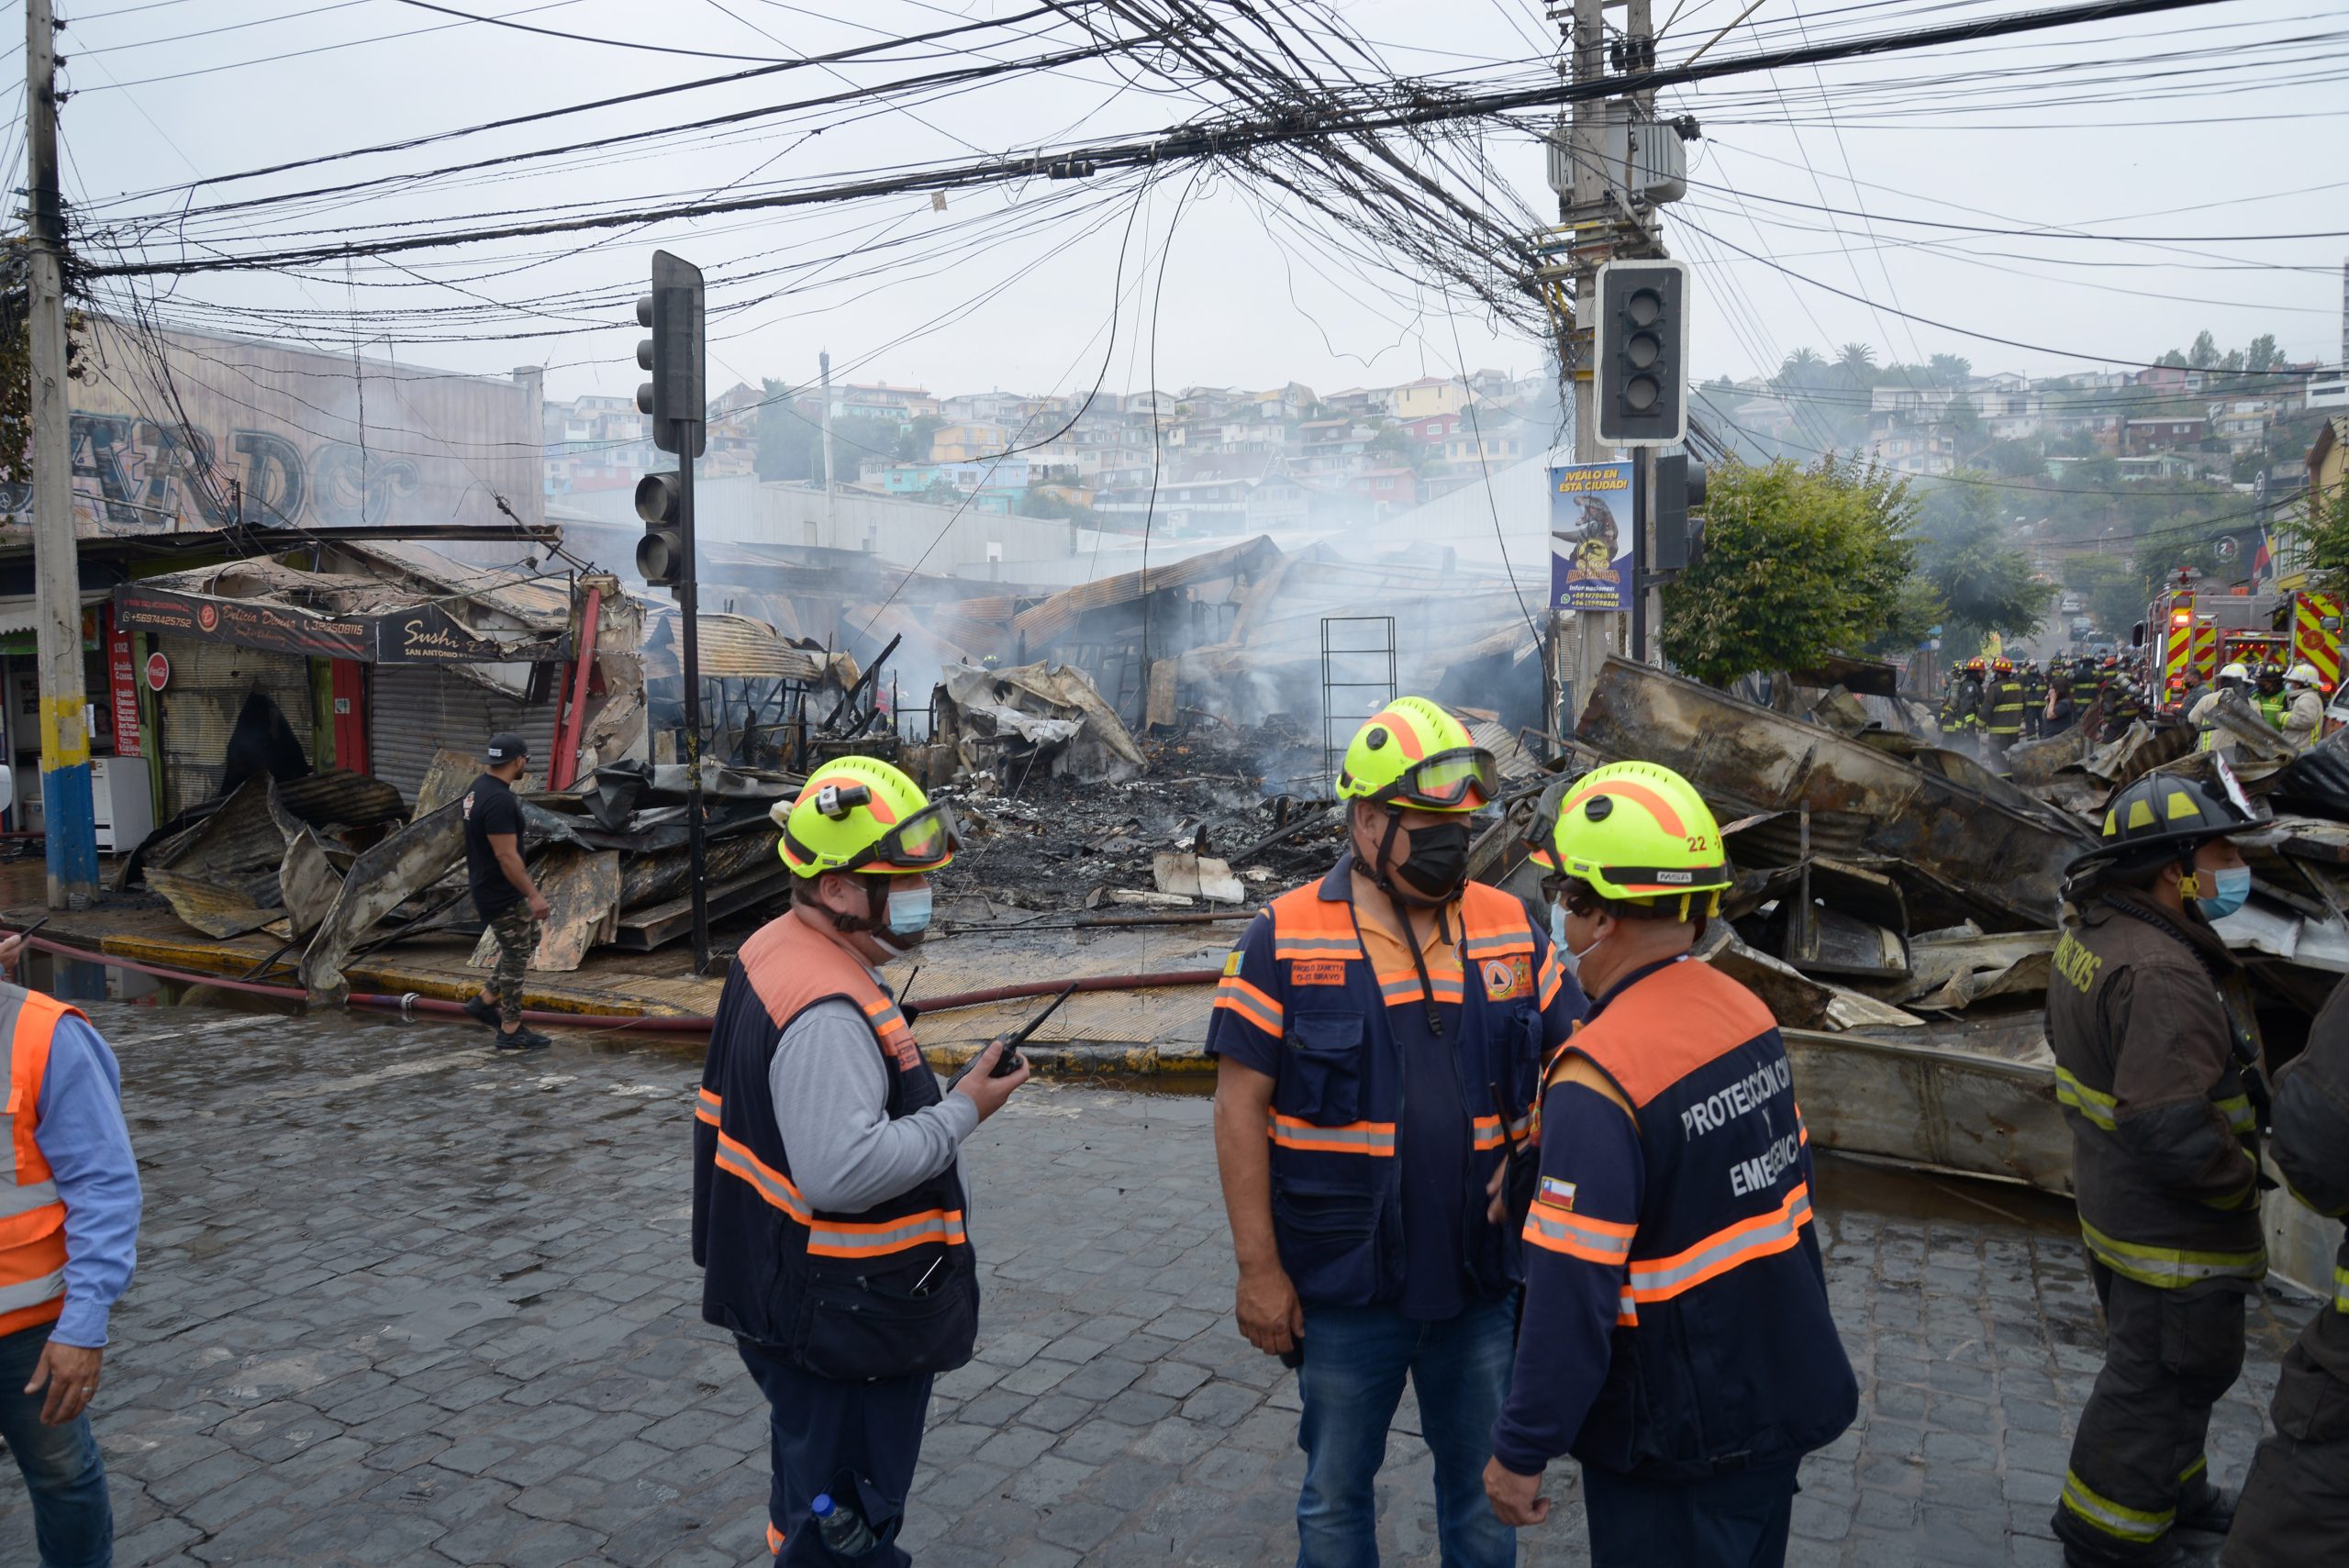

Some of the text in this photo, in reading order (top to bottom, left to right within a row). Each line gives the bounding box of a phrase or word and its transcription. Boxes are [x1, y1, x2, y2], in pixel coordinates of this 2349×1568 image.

[1604, 469, 1619, 479] EN
[1559, 480, 1629, 493] ESTA CIUDAD!
[131, 614, 192, 628] +56974425752
[222, 605, 258, 624] Delicia
[404, 619, 459, 649] Sushi
[405, 648, 421, 656] SAN
[423, 648, 458, 659] ANTONIO
[1687, 836, 1707, 853] 22
[1660, 873, 1689, 881] MSA
[1681, 1061, 1780, 1142] PROTECCIÓN
[1762, 1106, 1773, 1139] Y
